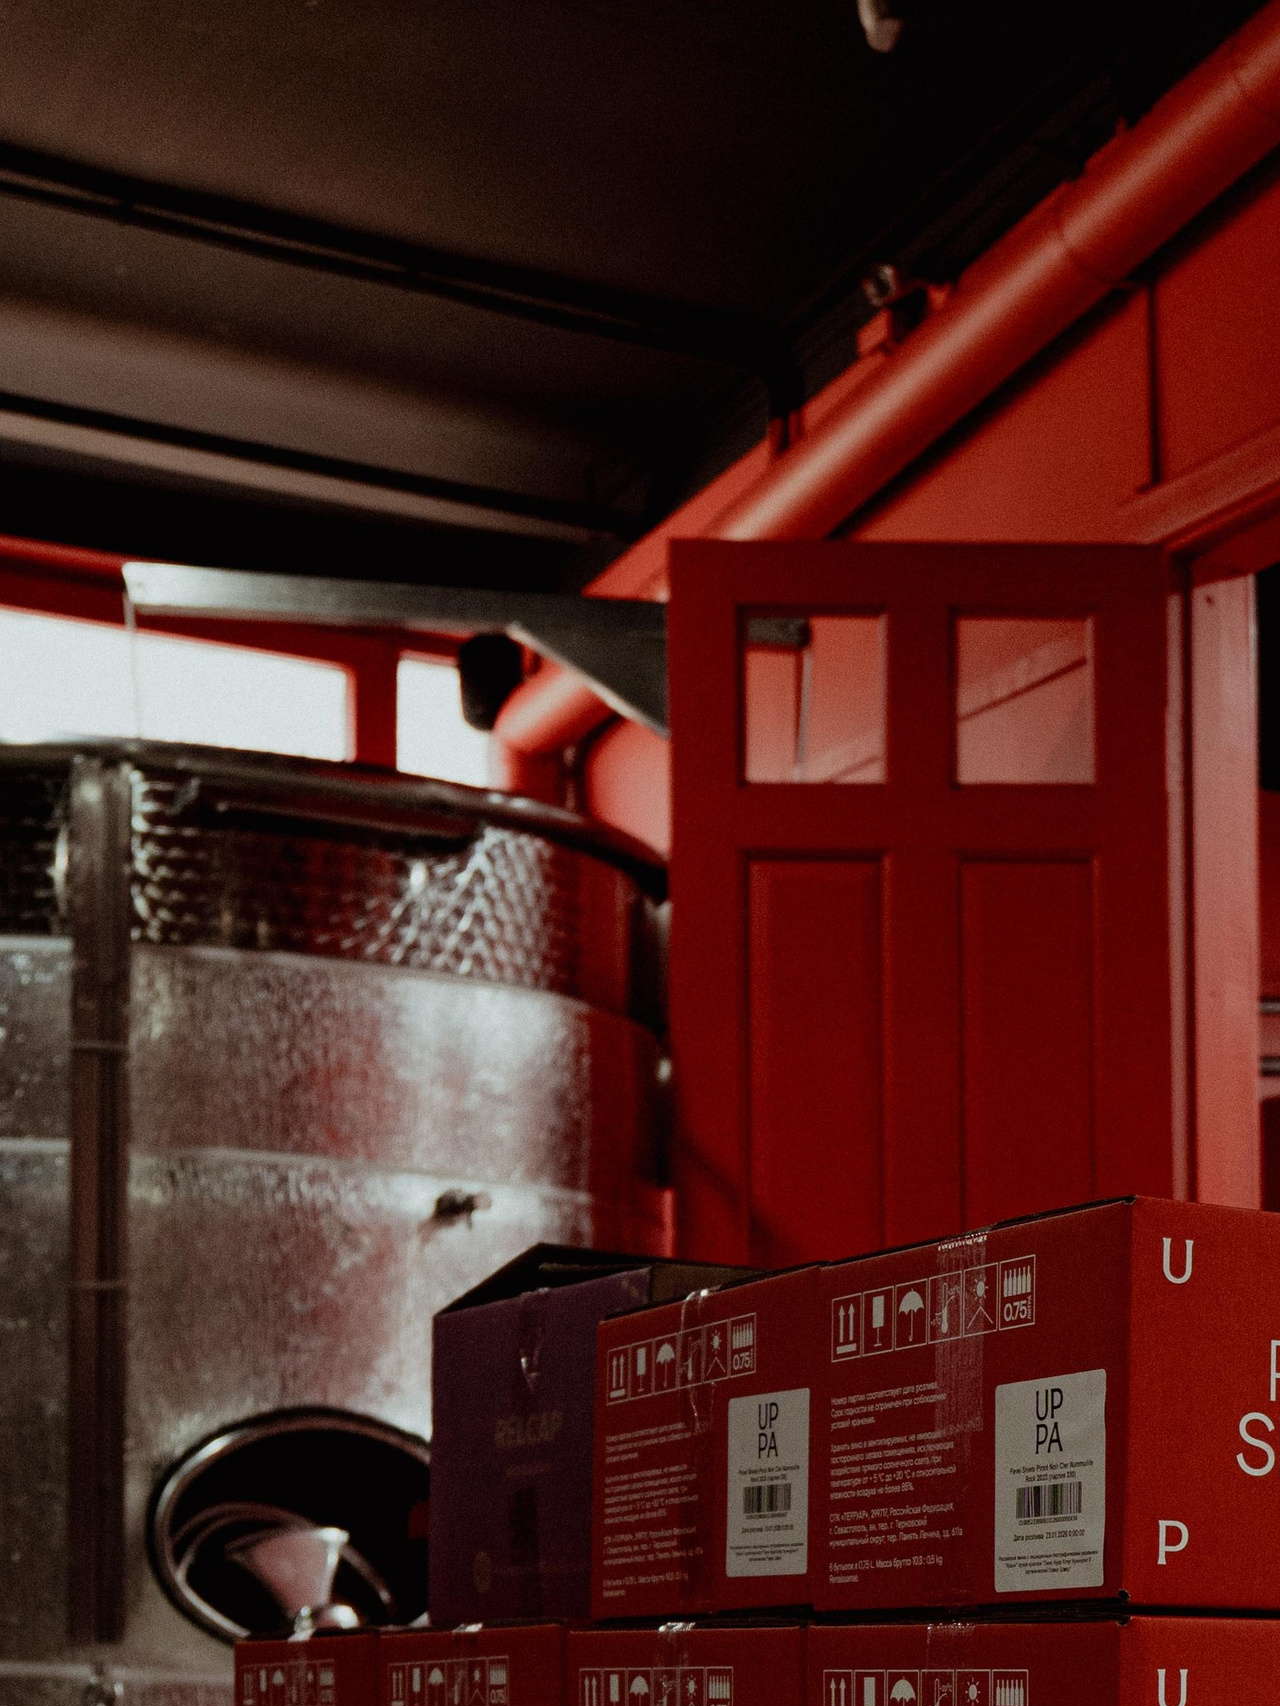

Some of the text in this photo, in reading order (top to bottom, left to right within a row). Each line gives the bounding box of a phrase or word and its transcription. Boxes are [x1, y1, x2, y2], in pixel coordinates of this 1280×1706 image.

[1162, 1237, 1194, 1284] U
[1004, 1300, 1028, 1321] 0.75
[758, 1402, 778, 1429] UP
[1035, 1388, 1064, 1420] UP
[758, 1432, 778, 1459] PA
[1035, 1421, 1063, 1454] PA
[1157, 1519, 1189, 1566] P
